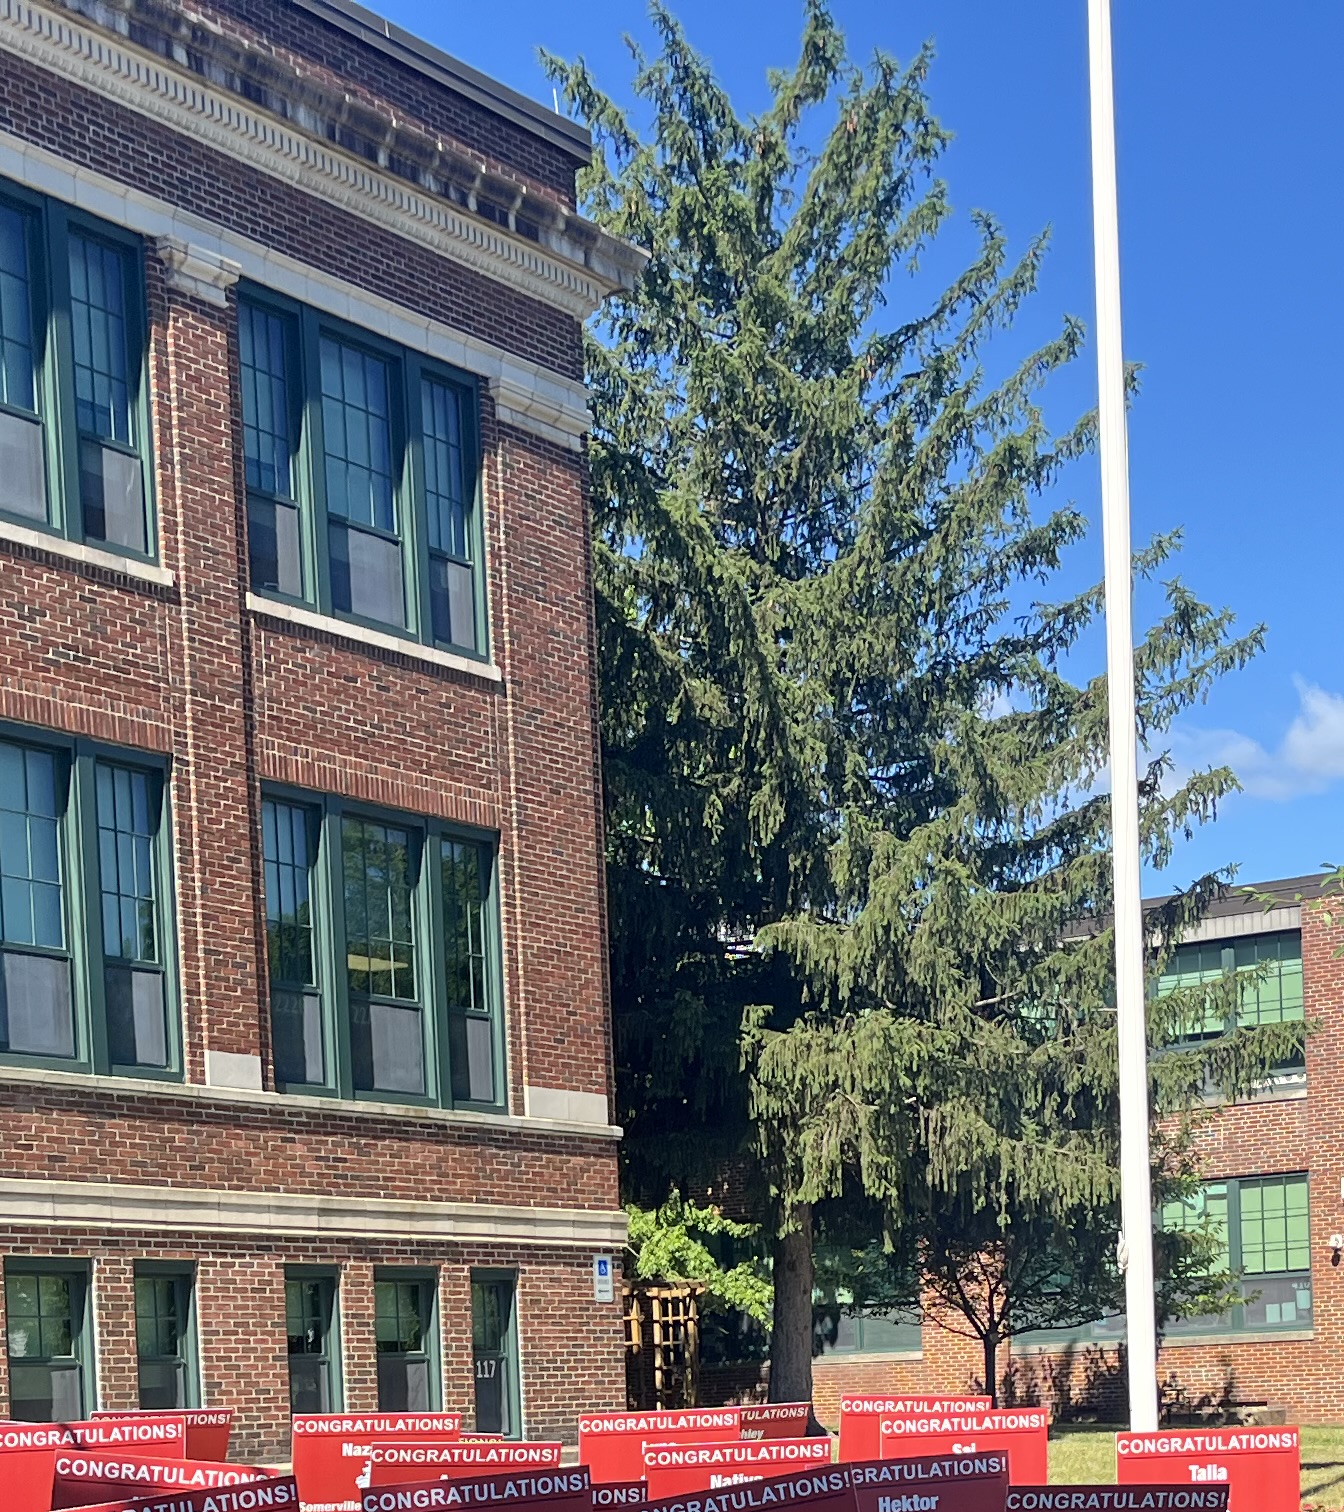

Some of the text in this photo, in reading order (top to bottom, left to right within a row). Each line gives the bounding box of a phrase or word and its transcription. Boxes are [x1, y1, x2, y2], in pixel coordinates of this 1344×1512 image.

[476, 1360, 497, 1378] 117
[294, 1419, 459, 1432] CONGRATULATIONS!
[580, 1413, 738, 1432] CONGRATULATIONS!
[882, 1415, 1044, 1433] CONGRATULATIONS!
[1118, 1433, 1297, 1454] CONGRATULATIONS!
[372, 1449, 558, 1462] CONGRATULATIONS!
[644, 1444, 828, 1465] CONGRATULATIONS!
[1189, 1464, 1227, 1481] Talia
[364, 1473, 588, 1512] CONGRATULATIONS!
[1006, 1492, 1225, 1509] CONGRATULATIONS!
[299, 1501, 362, 1512] Somerville
